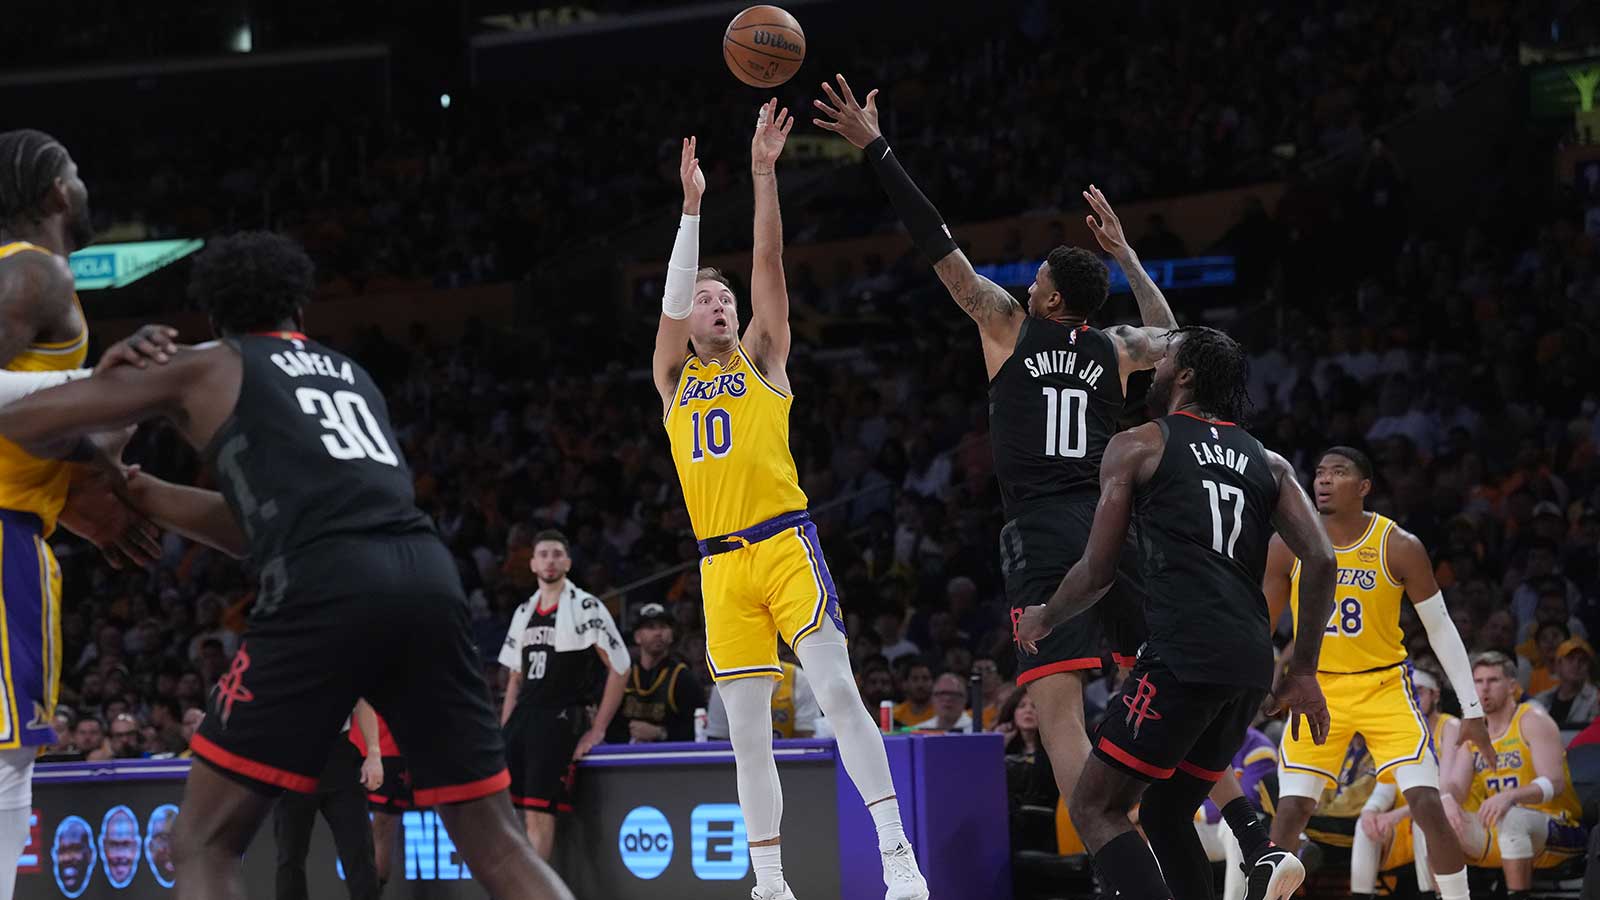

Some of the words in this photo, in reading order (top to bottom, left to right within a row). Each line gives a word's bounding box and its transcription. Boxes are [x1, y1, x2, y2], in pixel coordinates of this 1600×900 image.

[754, 30, 801, 55] Wilson
[270, 350, 355, 385] CAPELA
[1024, 350, 1077, 378] SMITH
[1078, 359, 1104, 391] JR.
[295, 387, 399, 467] 30
[691, 407, 732, 463] 10
[1042, 386, 1088, 459] 10
[1189, 441, 1249, 475] EASON
[1201, 479, 1245, 559] 17
[527, 651, 547, 680] 28
[625, 828, 669, 852] abc
